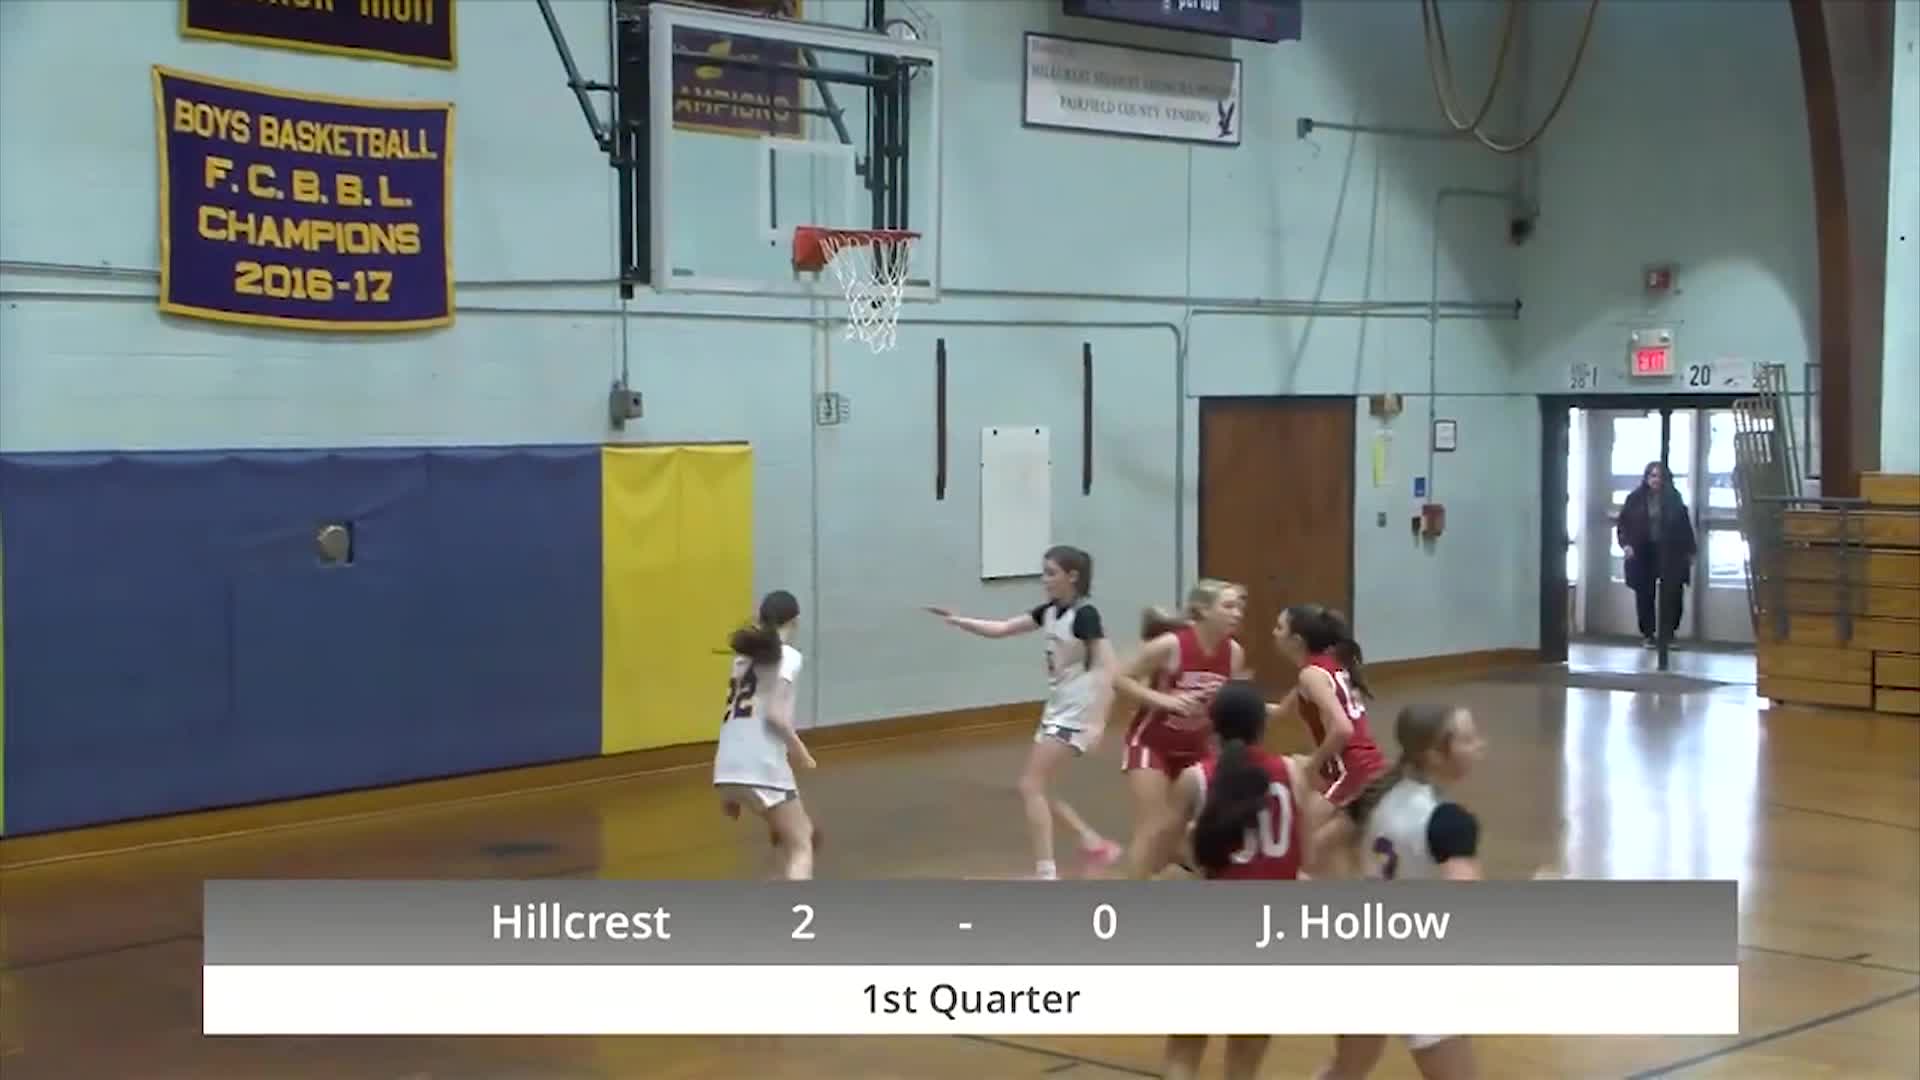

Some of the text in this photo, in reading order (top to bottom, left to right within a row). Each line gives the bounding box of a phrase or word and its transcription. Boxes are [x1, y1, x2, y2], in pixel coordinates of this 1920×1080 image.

[174, 98, 438, 160] BOYS BASKETBALL
[198, 204, 421, 254] CHAMPIONS
[234, 260, 393, 303] 2016-17
[1690, 364, 1711, 387] 20
[1229, 782, 1293, 864] 0
